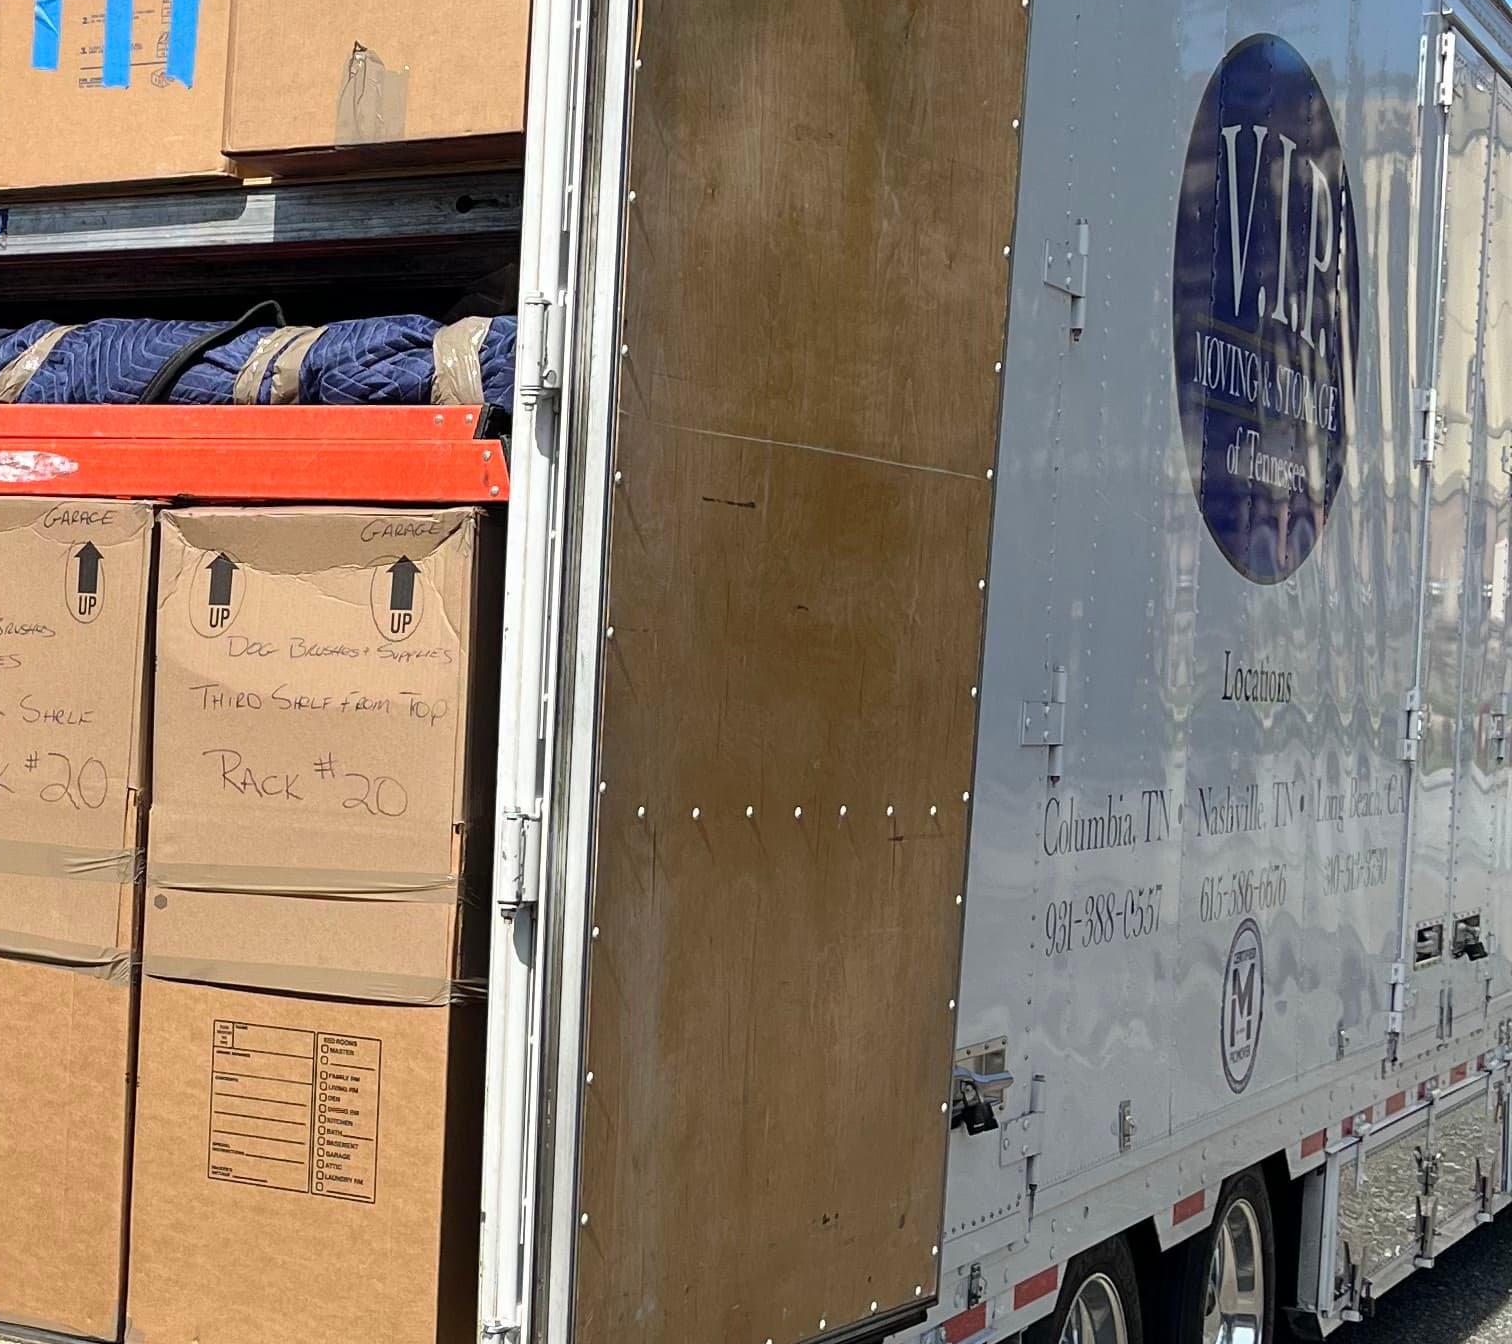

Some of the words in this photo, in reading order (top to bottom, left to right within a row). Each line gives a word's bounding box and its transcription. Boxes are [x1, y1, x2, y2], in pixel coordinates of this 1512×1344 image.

[1221, 124, 1334, 356] V.I.P.
[1193, 331, 1259, 403] MOVING
[1262, 360, 1273, 409] &
[1275, 363, 1338, 432] STORAGE
[1226, 426, 1243, 475] of
[1246, 429, 1307, 494] Tennessee
[43, 506, 118, 529] GARAGE
[360, 518, 442, 543] GARAGE
[78, 595, 97, 616] UP
[208, 607, 231, 628] UP
[390, 612, 413, 634] UP
[227, 635, 279, 657] DOG
[1221, 650, 1293, 704] Locations
[189, 683, 263, 711] THIRD
[399, 690, 449, 727] TOP
[201, 748, 304, 801] RACK
[1043, 794, 1137, 857] Columbia,
[1141, 788, 1175, 843] TN
[1196, 783, 1266, 837] Nashville,
[1272, 780, 1296, 828] TN
[1315, 778, 1345, 833] Long
[1045, 883, 1164, 957] 931-388-0557
